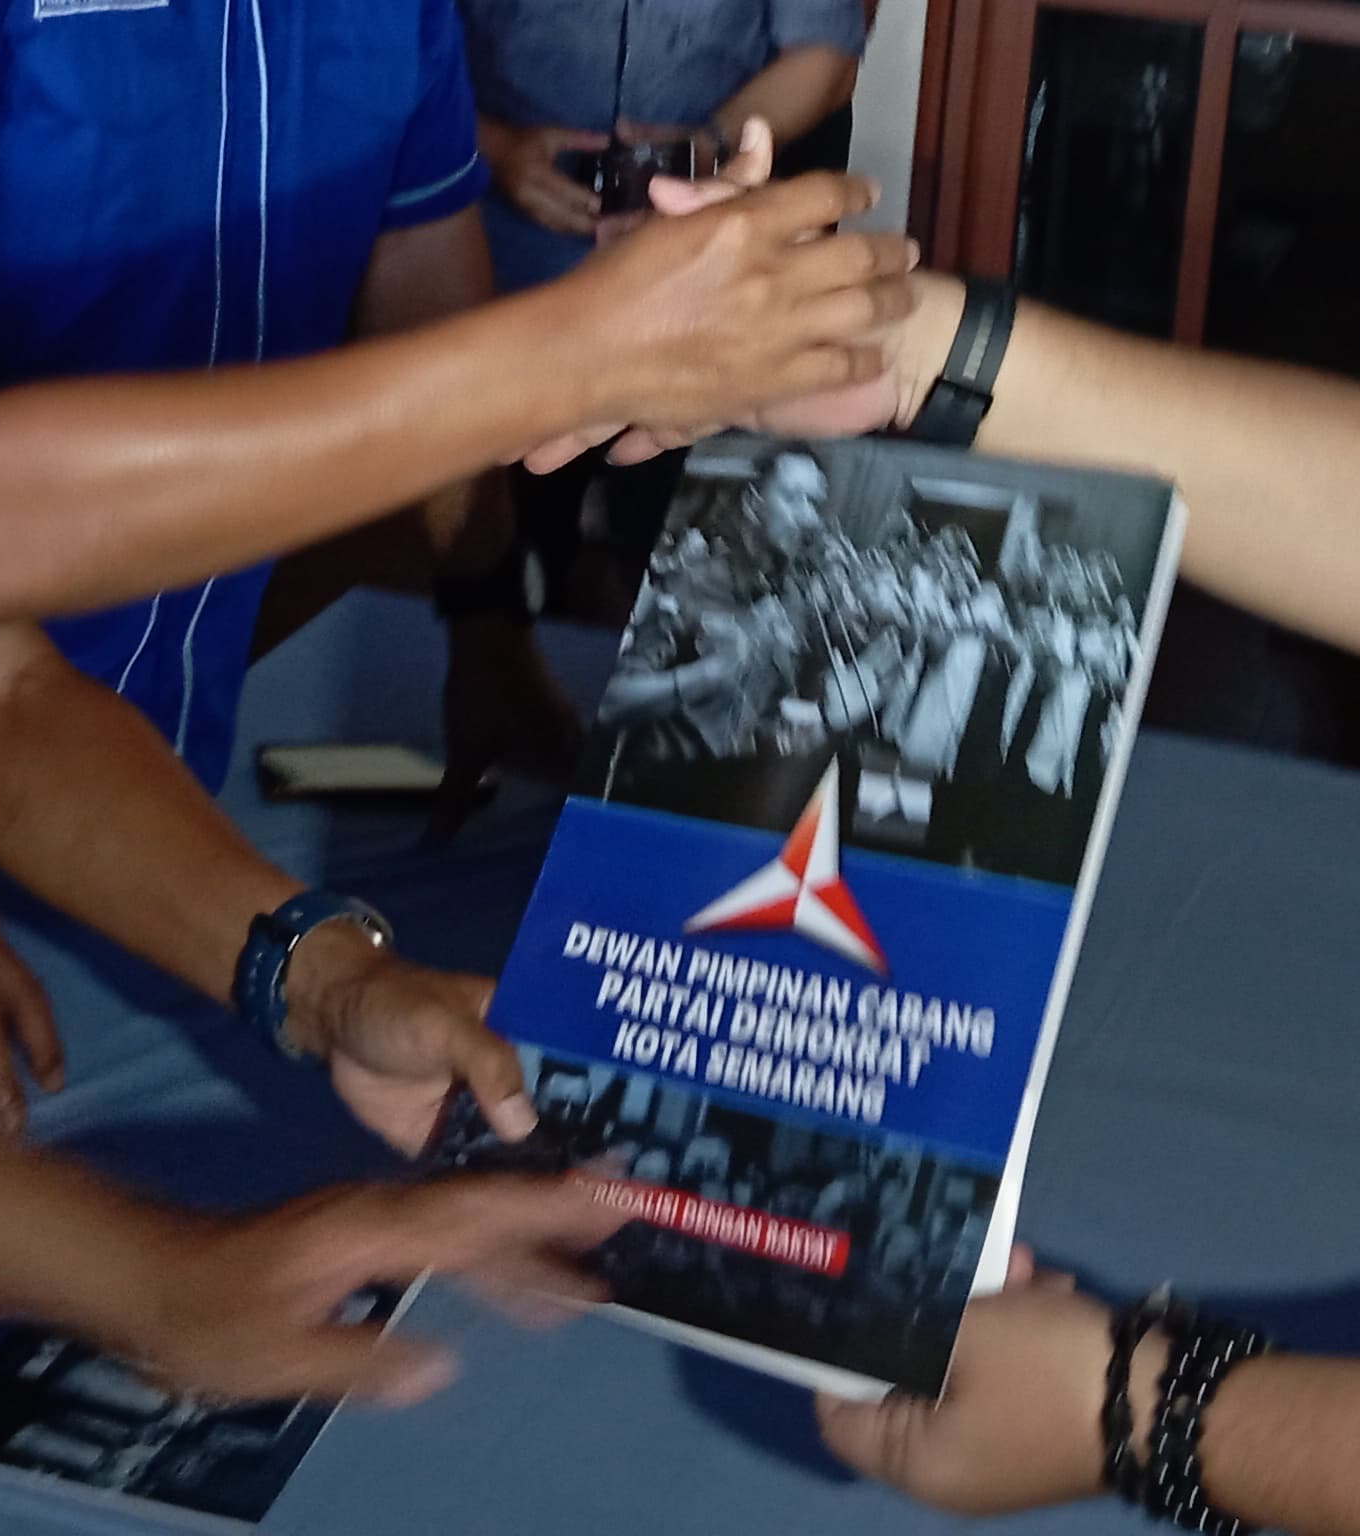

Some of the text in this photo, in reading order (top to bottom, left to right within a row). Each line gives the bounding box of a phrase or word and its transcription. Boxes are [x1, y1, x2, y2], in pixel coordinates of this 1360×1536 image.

[562, 921, 683, 981] DEWAN
[687, 947, 852, 1021] PIMPINAN
[595, 968, 931, 1088] PARTAI DEMOKRAT
[611, 1017, 886, 1125] KOTA SEMARANG
